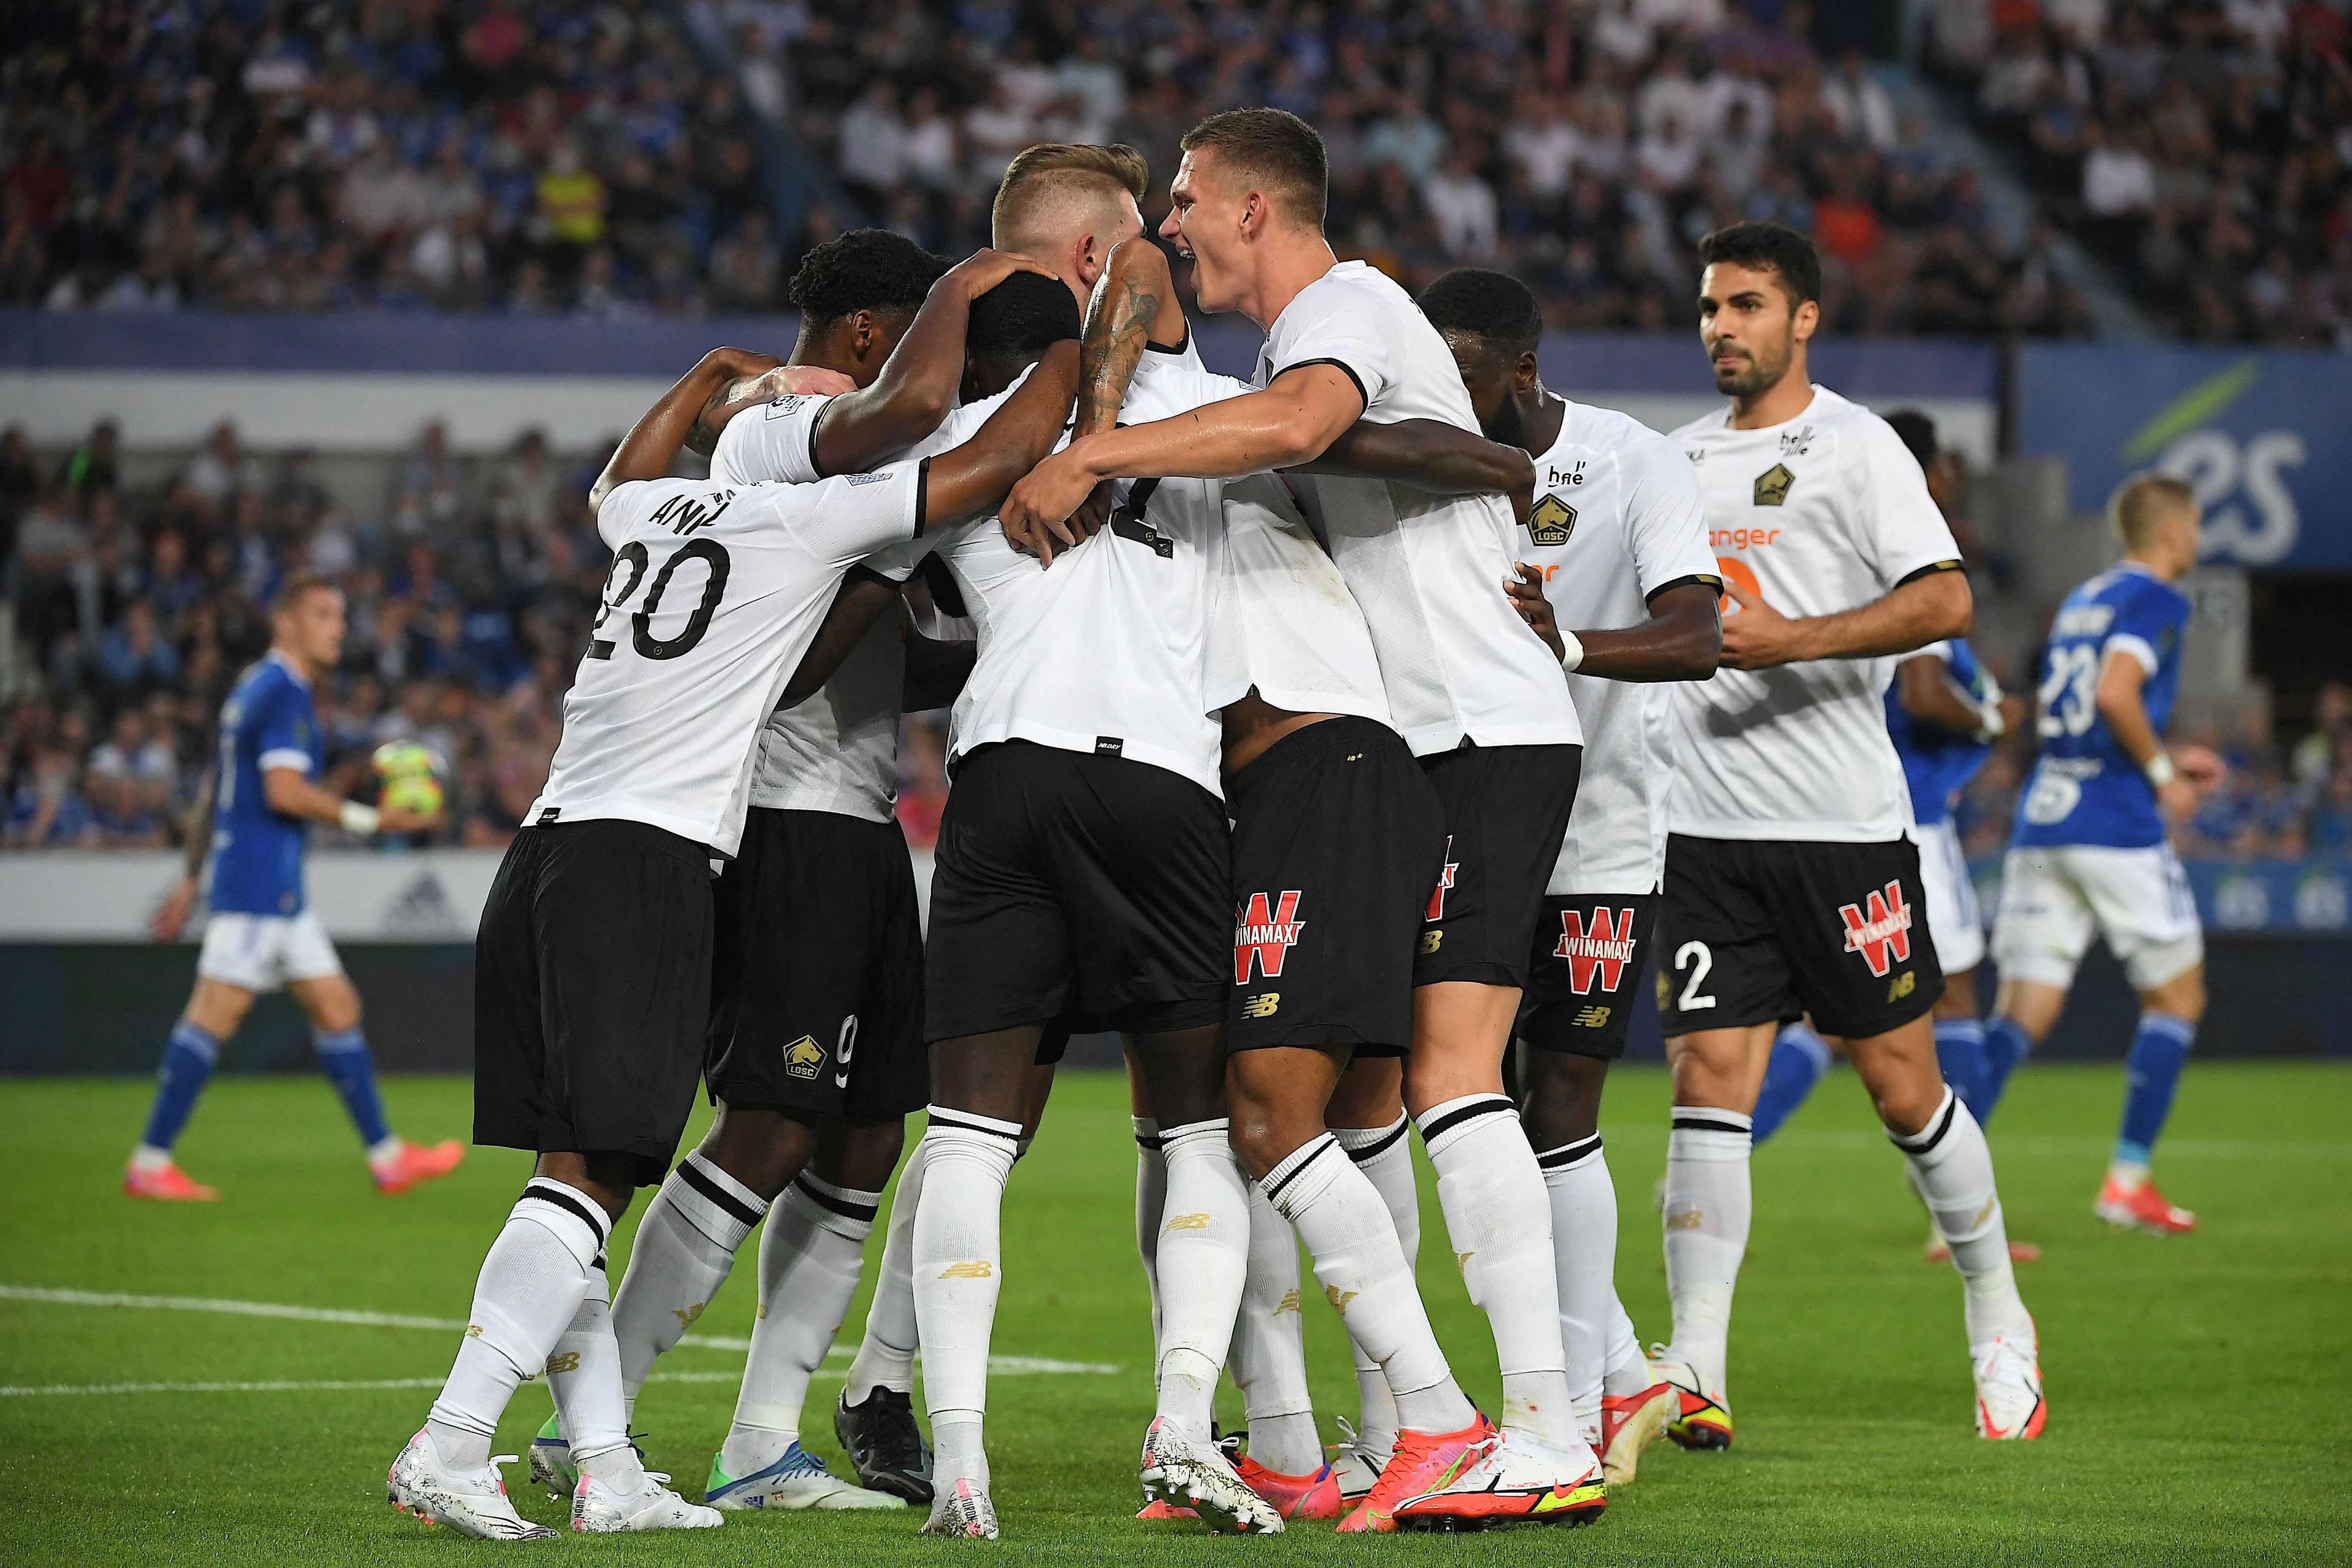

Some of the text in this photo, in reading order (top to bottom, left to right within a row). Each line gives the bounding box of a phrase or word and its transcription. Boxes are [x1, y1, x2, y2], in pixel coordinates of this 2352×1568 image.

[1538, 531, 1564, 541] LOSC
[587, 537, 730, 660] 20
[2036, 643, 2099, 737] 23
[1565, 937, 1630, 961] WINAMAX
[1675, 940, 1716, 1011] 2
[836, 1014, 857, 1088] 9
[790, 1065, 814, 1076] LOSC
[574, 1496, 586, 1519] FURON
[961, 1498, 979, 1523] FURON
